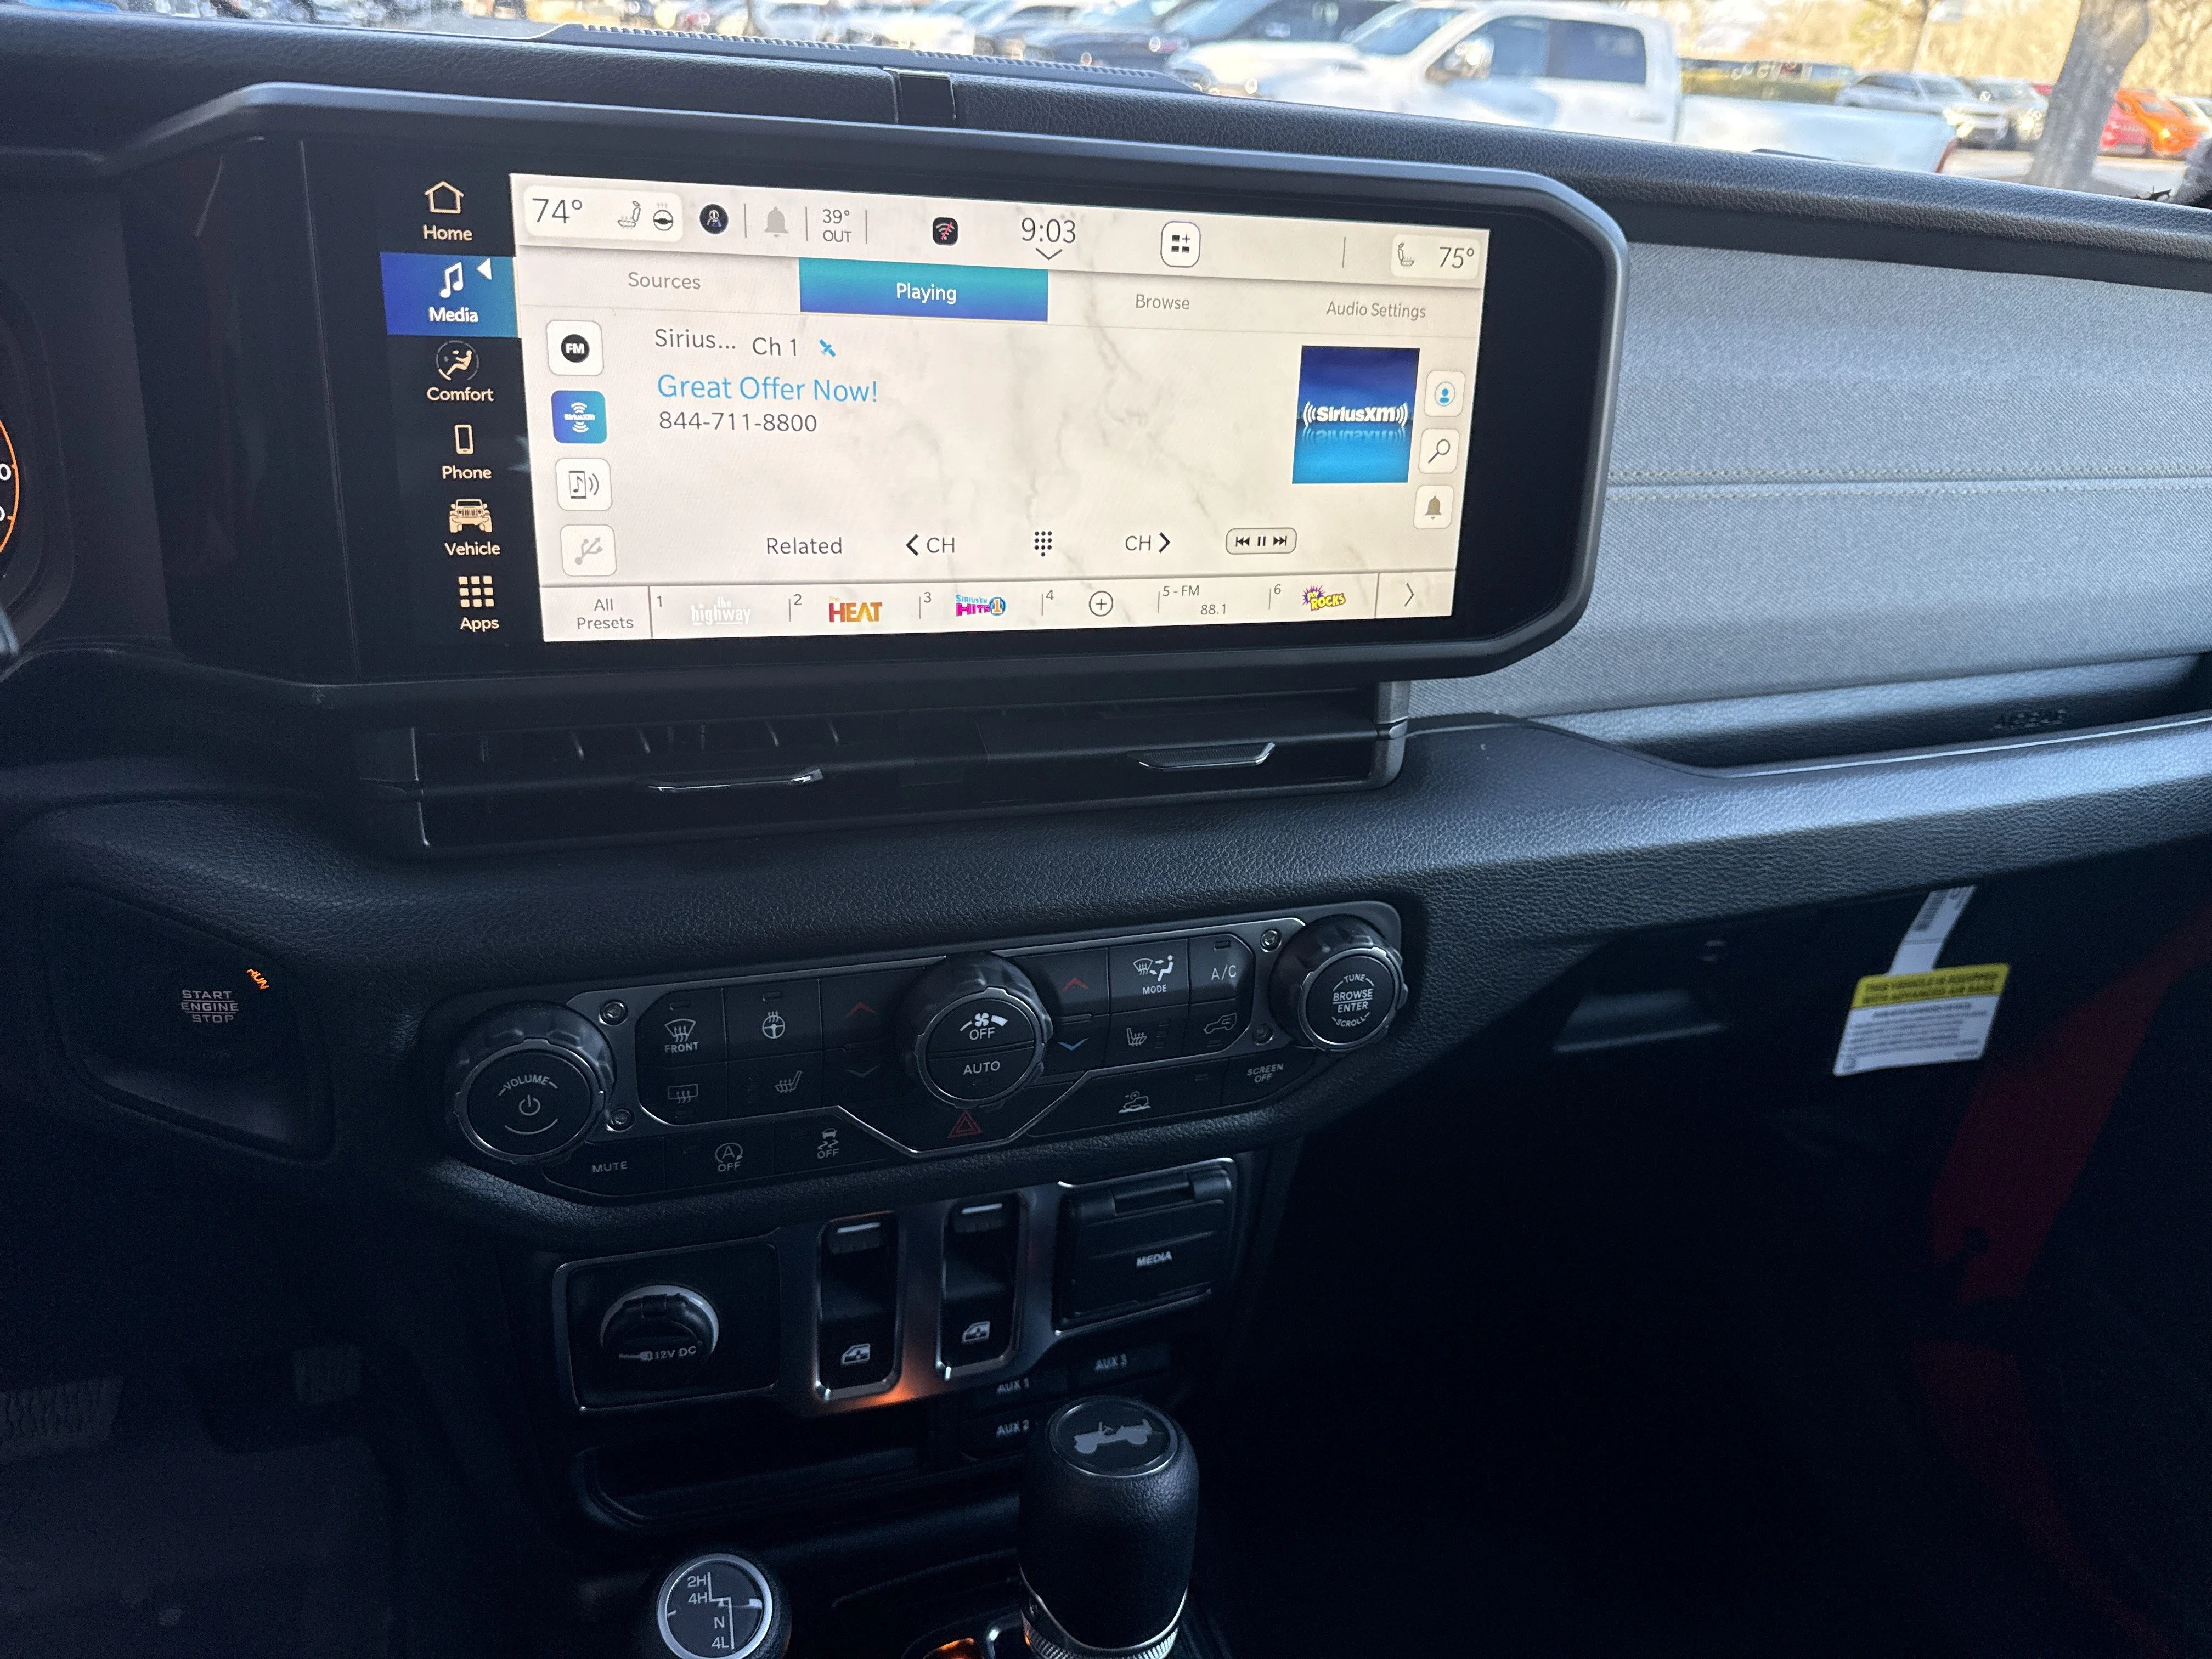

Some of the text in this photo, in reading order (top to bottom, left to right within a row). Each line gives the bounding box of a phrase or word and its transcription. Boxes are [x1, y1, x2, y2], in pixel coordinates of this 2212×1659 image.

[532, 198, 583, 224] 74°
[823, 209, 850, 224] 39°
[423, 225, 472, 242] Home
[823, 230, 851, 243] OUT
[1021, 218, 1076, 243] 9:03
[1439, 246, 1475, 268] 75°
[628, 272, 701, 290] Sources
[896, 283, 957, 304] Playing
[1136, 294, 1189, 311] Browse
[428, 307, 478, 323] Media
[1326, 301, 1426, 321] Audio Settings
[566, 343, 584, 355] FM
[655, 329, 797, 356] Sirius... Ch 1
[427, 387, 494, 402] Comfort
[658, 374, 877, 402] Great Offer Now!
[659, 411, 817, 433] 844-711-8800
[442, 466, 492, 480] Phone
[444, 542, 500, 556] Vehicle
[767, 537, 842, 555] Related
[927, 537, 955, 554] CH
[1125, 535, 1151, 551] CH
[1046, 590, 1054, 601] 4
[1163, 585, 1169, 597] 5
[1181, 585, 1199, 596] FM
[1274, 584, 1281, 595] 6
[657, 596, 662, 608] 1
[717, 596, 732, 608] the
[794, 594, 802, 606] 2
[924, 591, 932, 603] 3
[1311, 592, 1346, 611] ROCKS
[594, 598, 613, 611] All
[1201, 604, 1226, 616] 88.1
[691, 605, 751, 624] highway
[829, 602, 882, 623] HEAT
[460, 617, 499, 632] Apps
[577, 616, 634, 630] Presets
[247, 968, 269, 990] RUN
[1211, 965, 1237, 981] A/C
[1344, 974, 1365, 983] TUNE
[182, 990, 232, 1000] START
[1142, 985, 1167, 995] MODE
[1333, 988, 1373, 1001] BROWSE
[181, 1002, 239, 1012] ENGINE
[1337, 1001, 1369, 1013] ENTER
[192, 1014, 234, 1023] STOP
[1335, 1016, 1367, 1028] SCROLL
[969, 1027, 995, 1041] OFF
[665, 1041, 699, 1053] FRONT
[963, 1061, 1000, 1075] AUTO
[1247, 1063, 1283, 1076] SCREEN
[504, 1074, 549, 1091] VOLUME
[1254, 1073, 1273, 1083] OFF
[817, 1148, 839, 1159] OFF
[592, 1161, 628, 1173] MUTE
[718, 1161, 741, 1172] OFF
[1136, 1251, 1172, 1268] MEDIA
[655, 1346, 696, 1360] 12V DC
[1094, 1357, 1119, 1371] AUX
[996, 1381, 1021, 1395] AUX
[996, 1419, 1030, 1437] AUX 2
[687, 1574, 706, 1588] 2H
[687, 1592, 707, 1605] 4H
[714, 1616, 725, 1629] N
[712, 1636, 730, 1649] 4L
